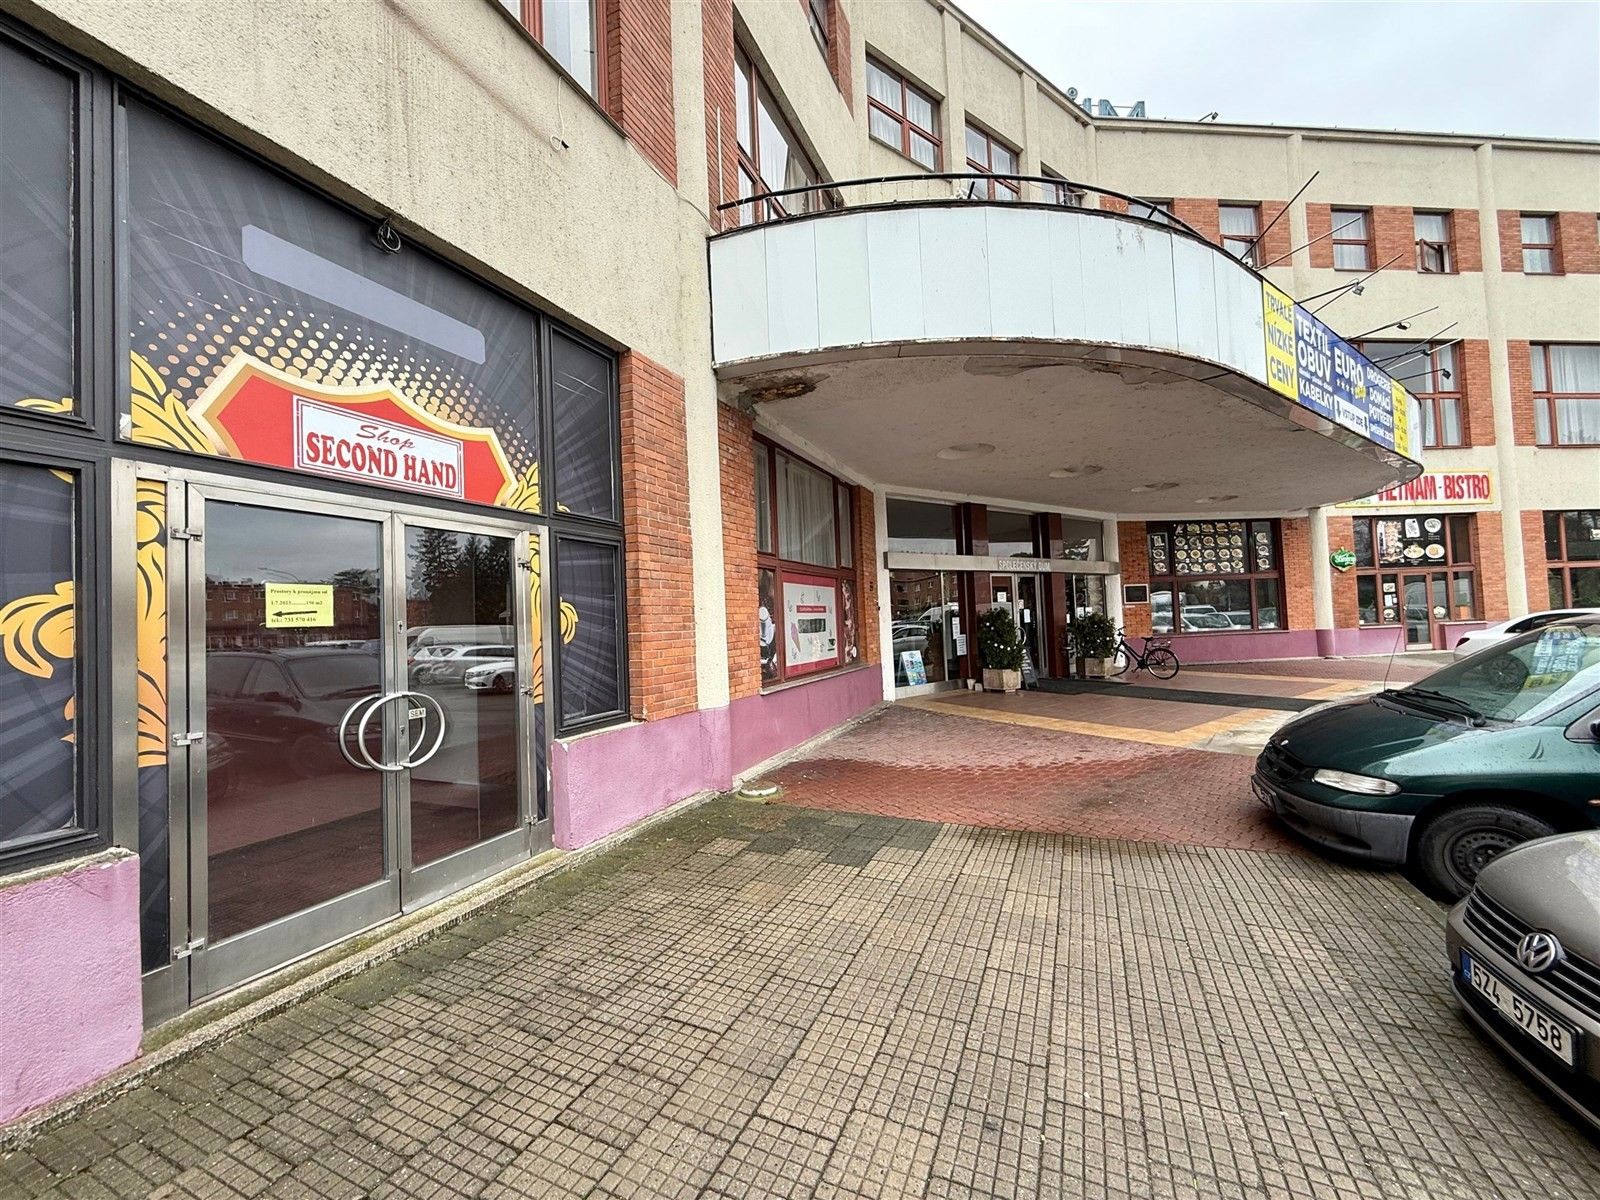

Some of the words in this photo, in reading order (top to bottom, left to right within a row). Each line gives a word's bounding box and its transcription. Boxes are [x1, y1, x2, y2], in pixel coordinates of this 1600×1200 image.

[1296, 313, 1331, 357] TEXTIL
[1269, 355, 1294, 389] CENY
[1297, 340, 1332, 383] OBUV
[1334, 346, 1364, 387] EURO
[1299, 377, 1334, 411] KABELKY
[355, 424, 416, 450] Shop
[305, 431, 398, 478] SECOND
[402, 453, 457, 489] HAND
[410, 708, 426, 718] SEM
[1472, 963, 1501, 1004] 5Z4
[1512, 996, 1562, 1052] 5758
